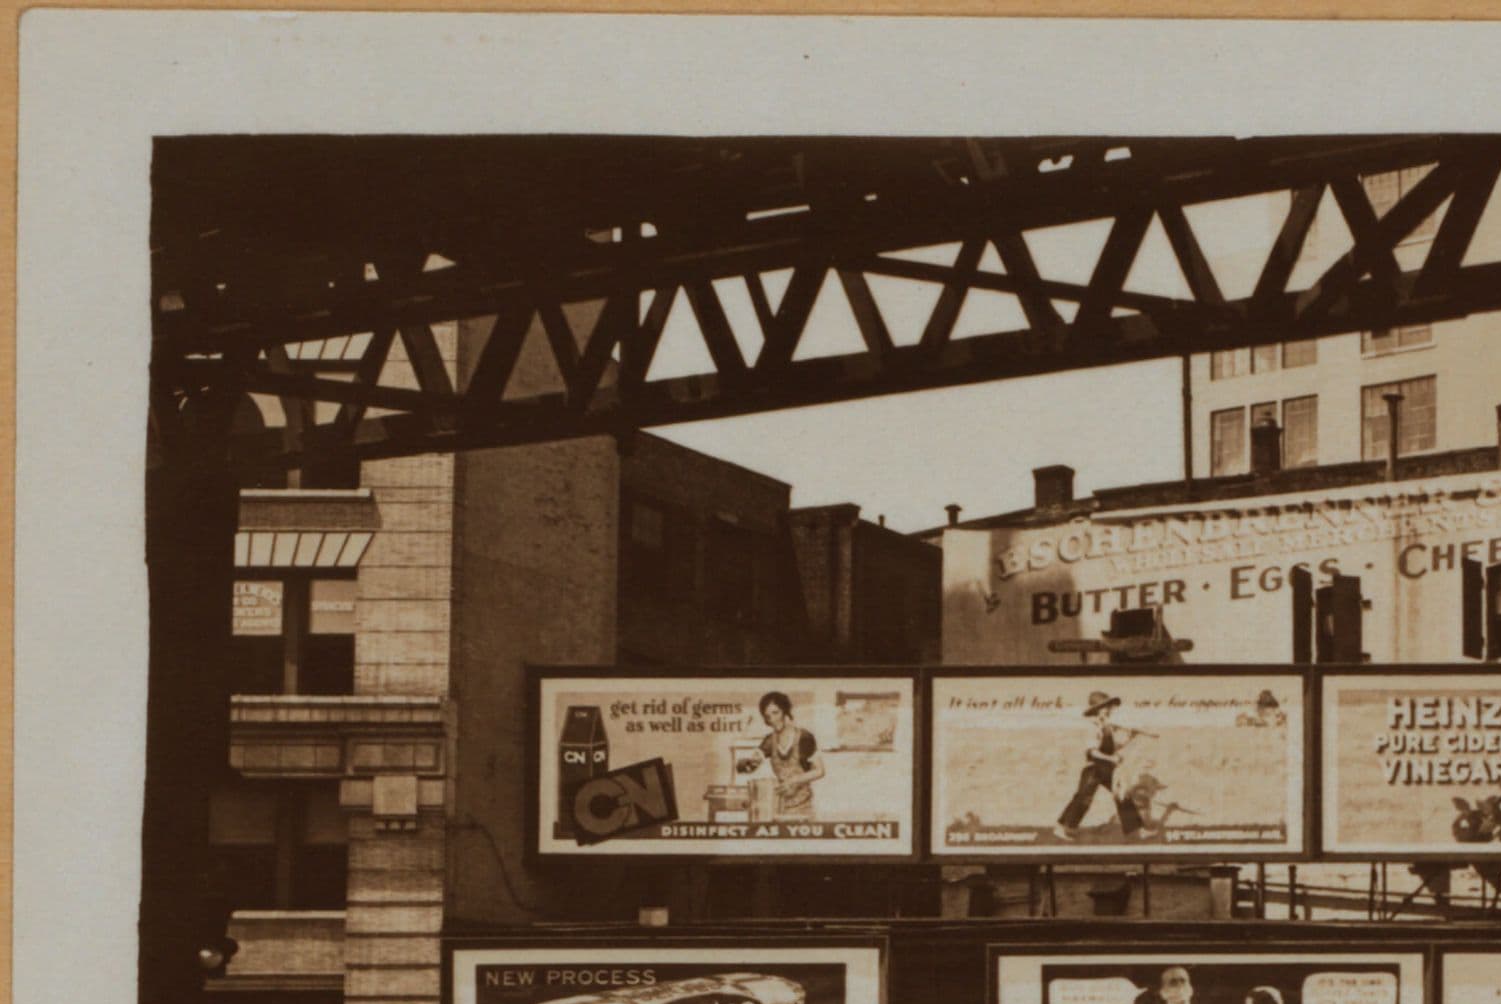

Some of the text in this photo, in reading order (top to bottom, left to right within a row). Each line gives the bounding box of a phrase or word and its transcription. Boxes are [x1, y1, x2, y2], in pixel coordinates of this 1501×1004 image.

[1031, 577, 1189, 626] BUTTER
[610, 696, 743, 719] get rid of germs
[625, 720, 643, 733] as
[648, 716, 682, 733] well
[686, 720, 705, 733] as
[1375, 732, 1440, 755] PURE
[564, 750, 587, 764] CN
[573, 763, 666, 836] CN
[660, 822, 893, 841] DISINFECT AS YOU CLEAN
[485, 968, 657, 987] NEW PROCESS
